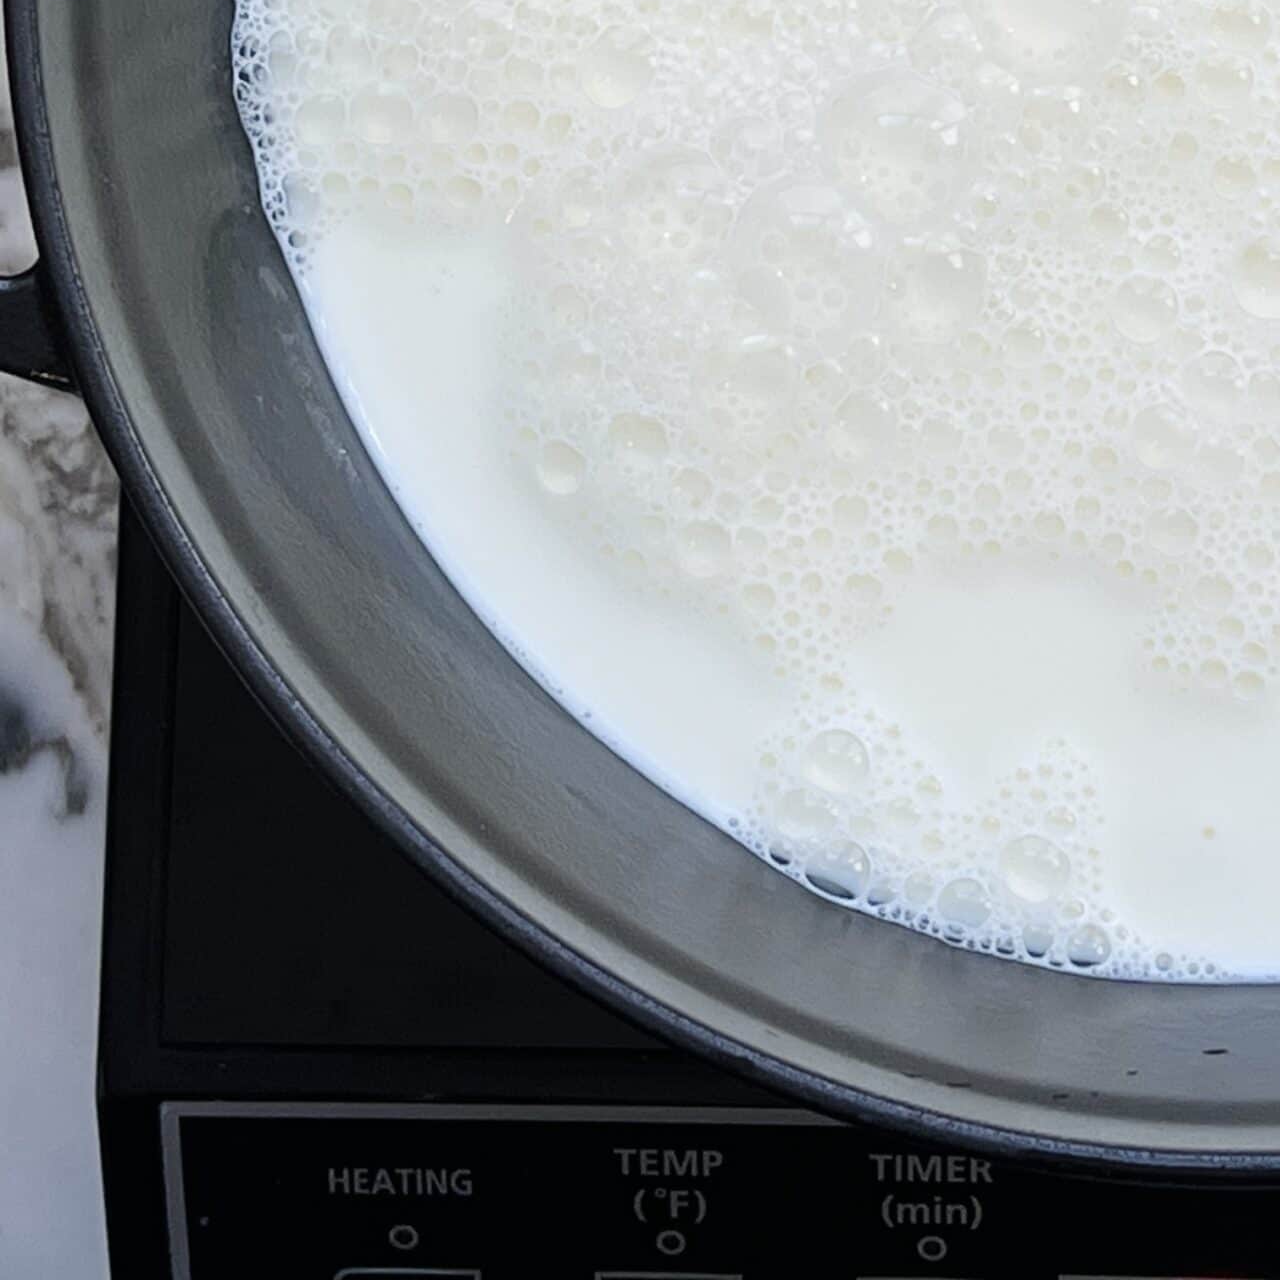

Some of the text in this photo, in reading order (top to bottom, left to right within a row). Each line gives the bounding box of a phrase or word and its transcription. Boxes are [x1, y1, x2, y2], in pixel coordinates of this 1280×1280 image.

[612, 1148, 724, 1177] TEMP
[868, 1154, 993, 1183] TIMER
[327, 1167, 473, 1196] HEATING
[881, 1194, 983, 1230] (min)
